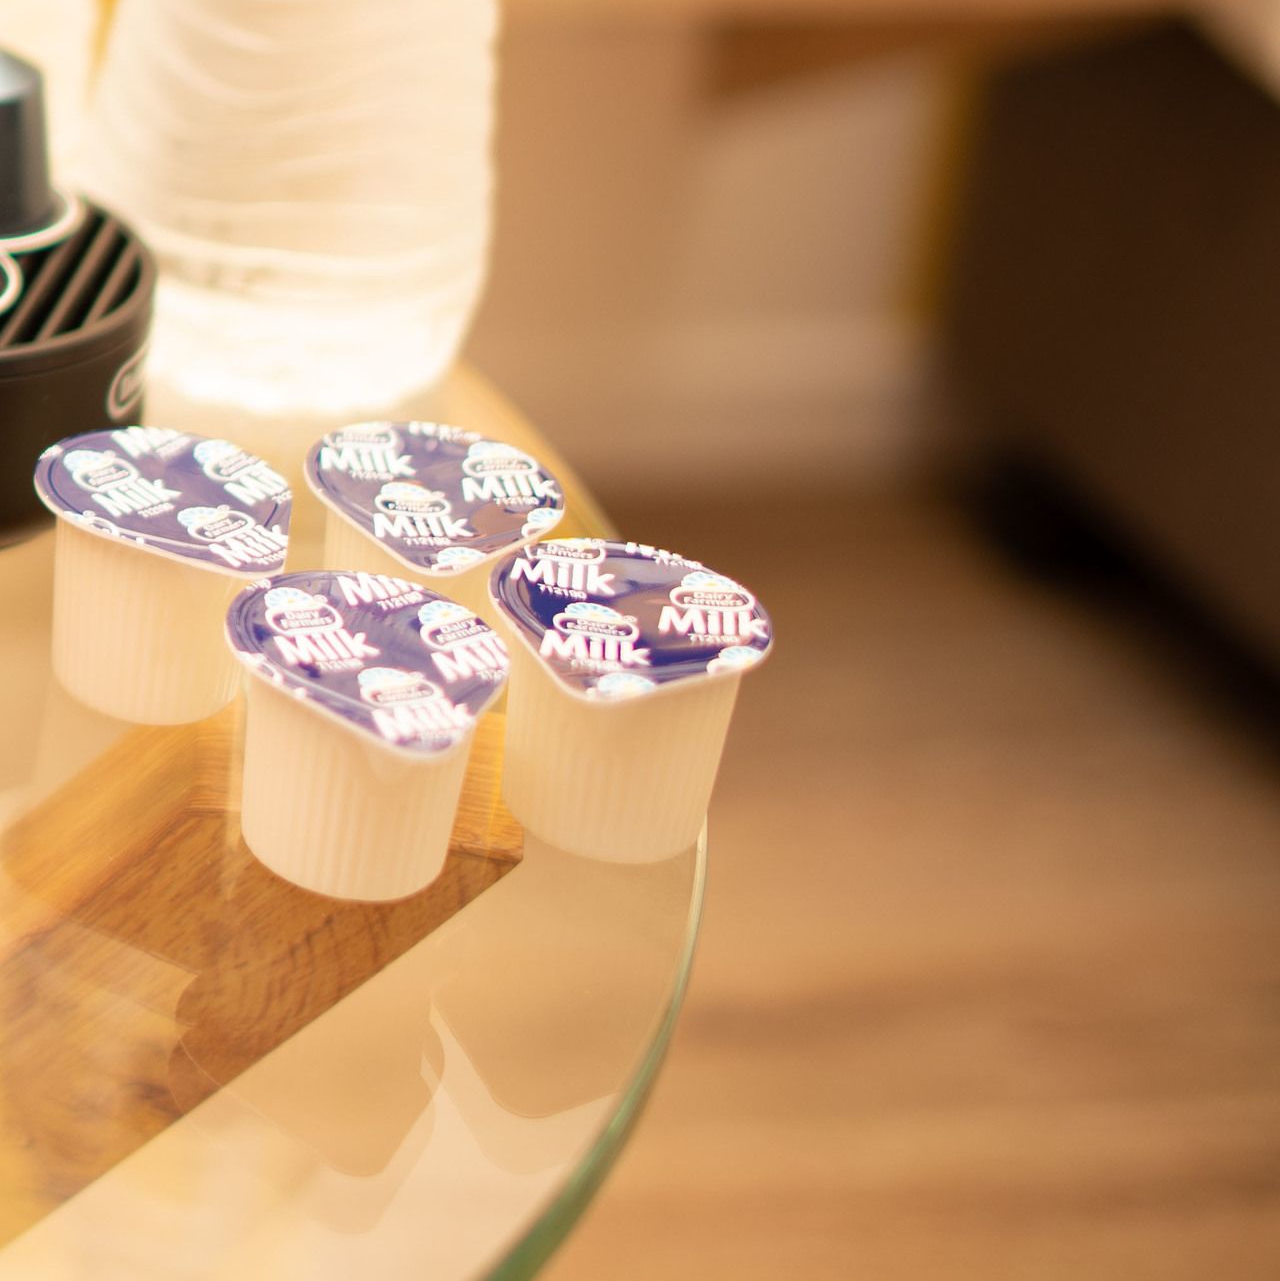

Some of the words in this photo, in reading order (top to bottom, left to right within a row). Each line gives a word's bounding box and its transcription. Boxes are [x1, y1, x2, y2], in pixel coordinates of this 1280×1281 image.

[320, 445, 417, 477] Milk
[91, 477, 182, 517] Milk
[224, 466, 291, 506] Mil
[461, 474, 562, 502] Milk
[373, 513, 474, 538] Milk
[510, 557, 616, 596] Milk
[658, 606, 769, 639] Milk
[273, 629, 381, 665] Milk
[431, 633, 510, 683] Mil
[539, 629, 652, 666] Milk
[372, 698, 476, 741] Milk
